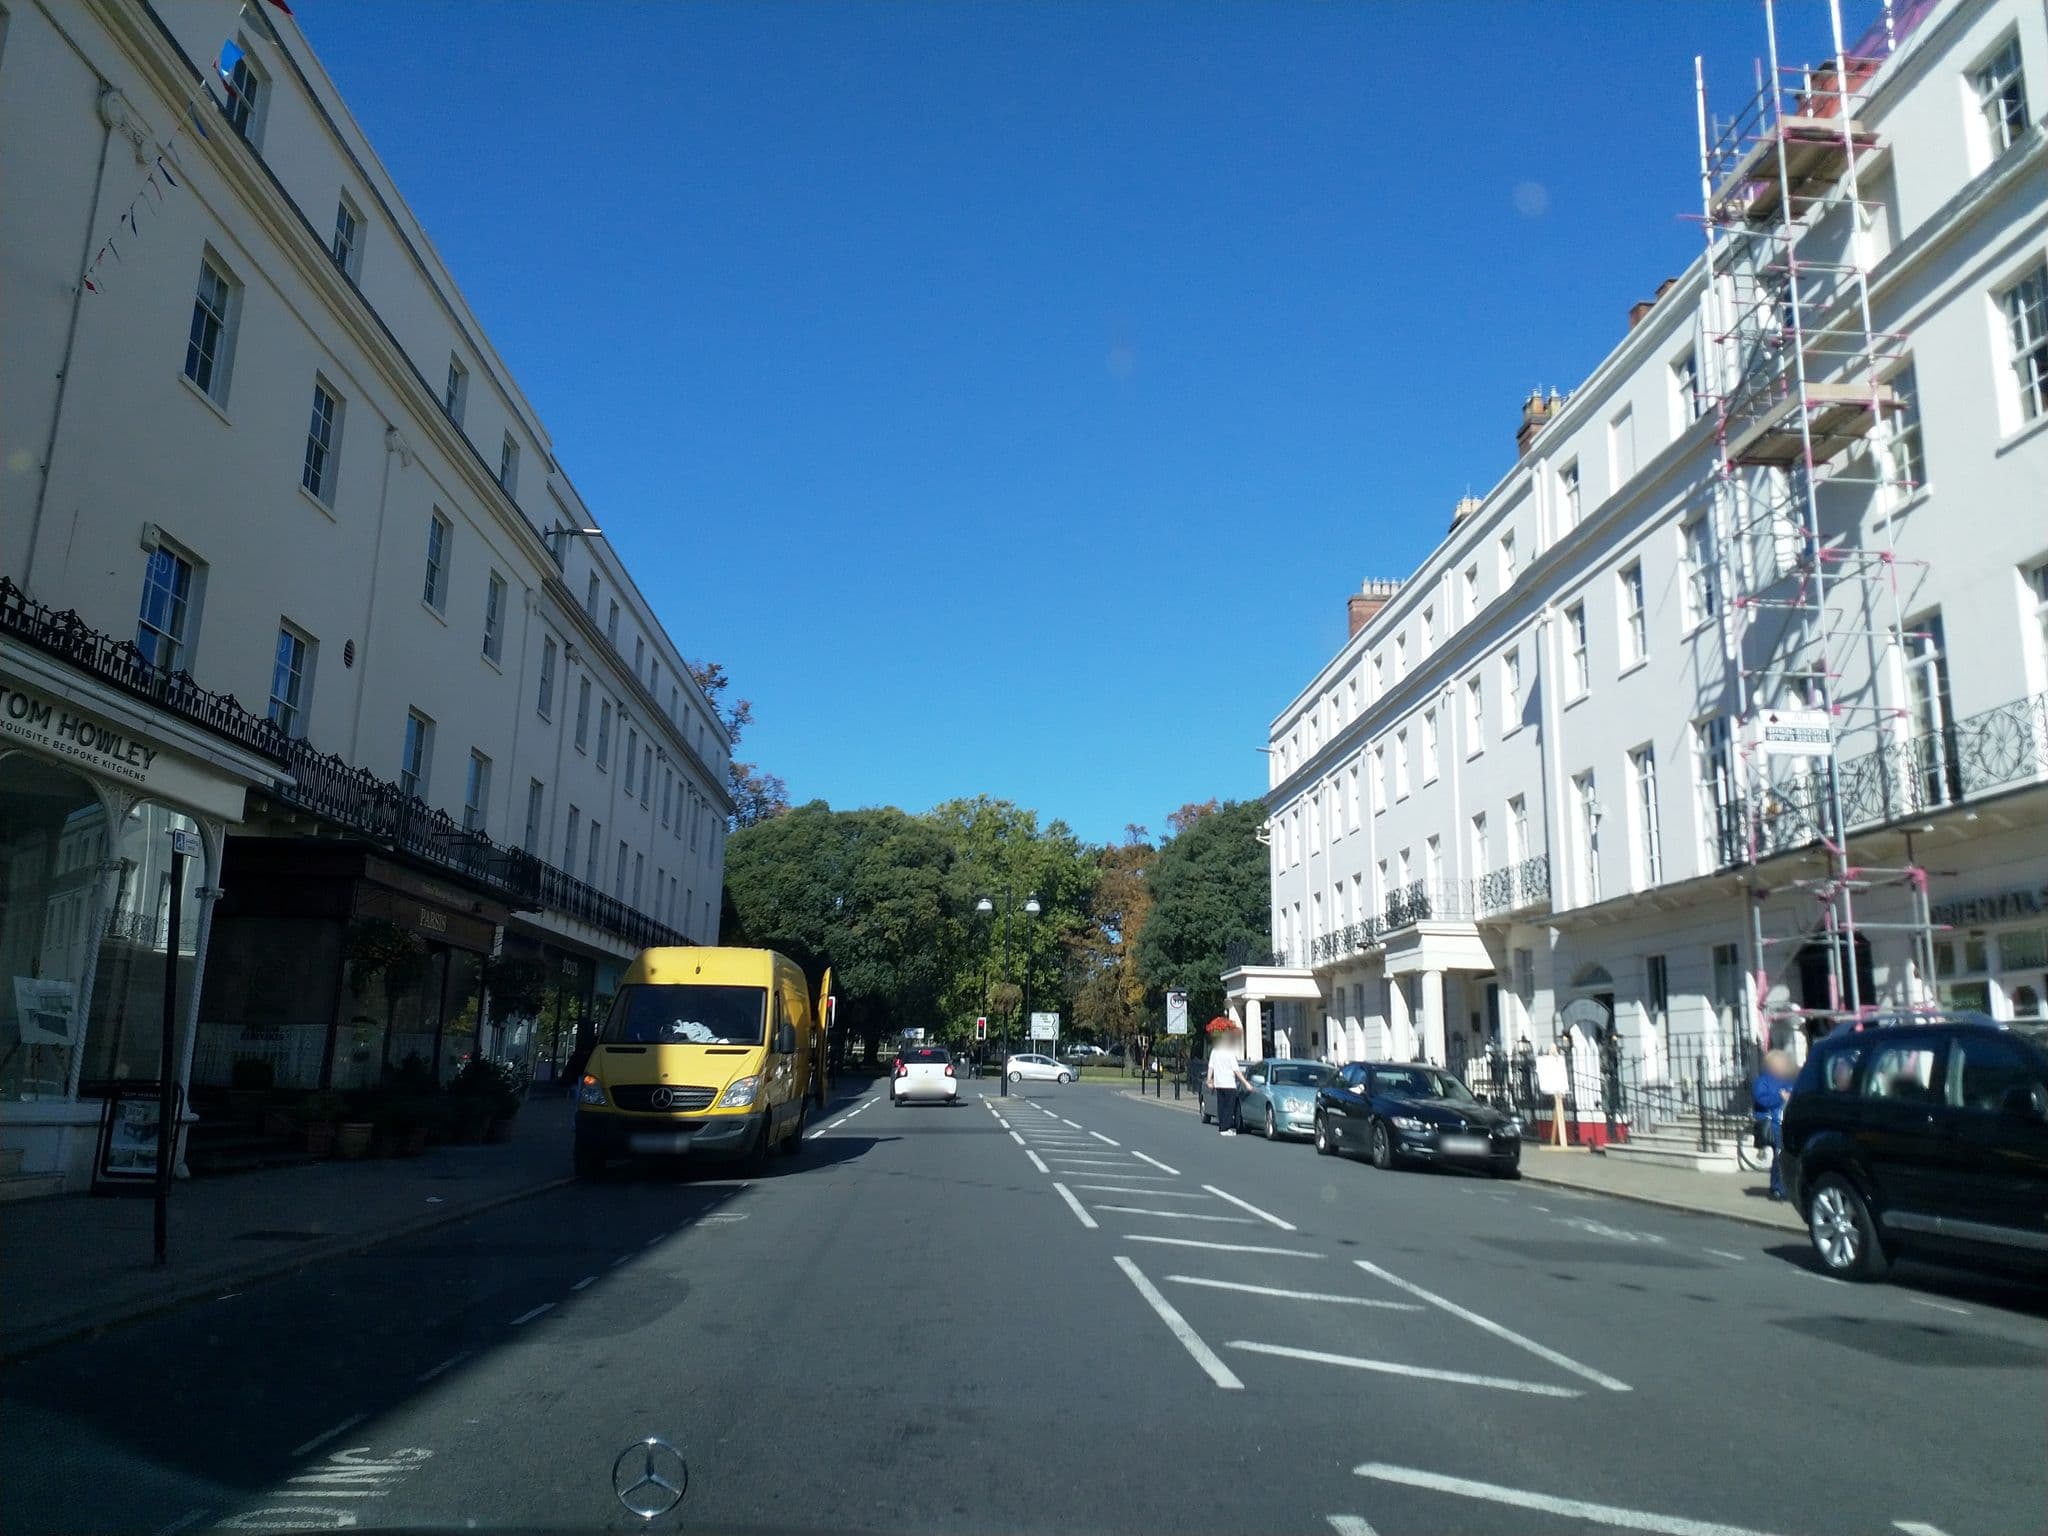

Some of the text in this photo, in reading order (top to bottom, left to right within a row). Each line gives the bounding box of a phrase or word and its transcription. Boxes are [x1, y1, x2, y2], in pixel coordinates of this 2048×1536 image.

[0, 685, 157, 770] TOM HOWLEY
[53, 740, 98, 765] BESPOKE
[102, 760, 146, 782] KITCHENS
